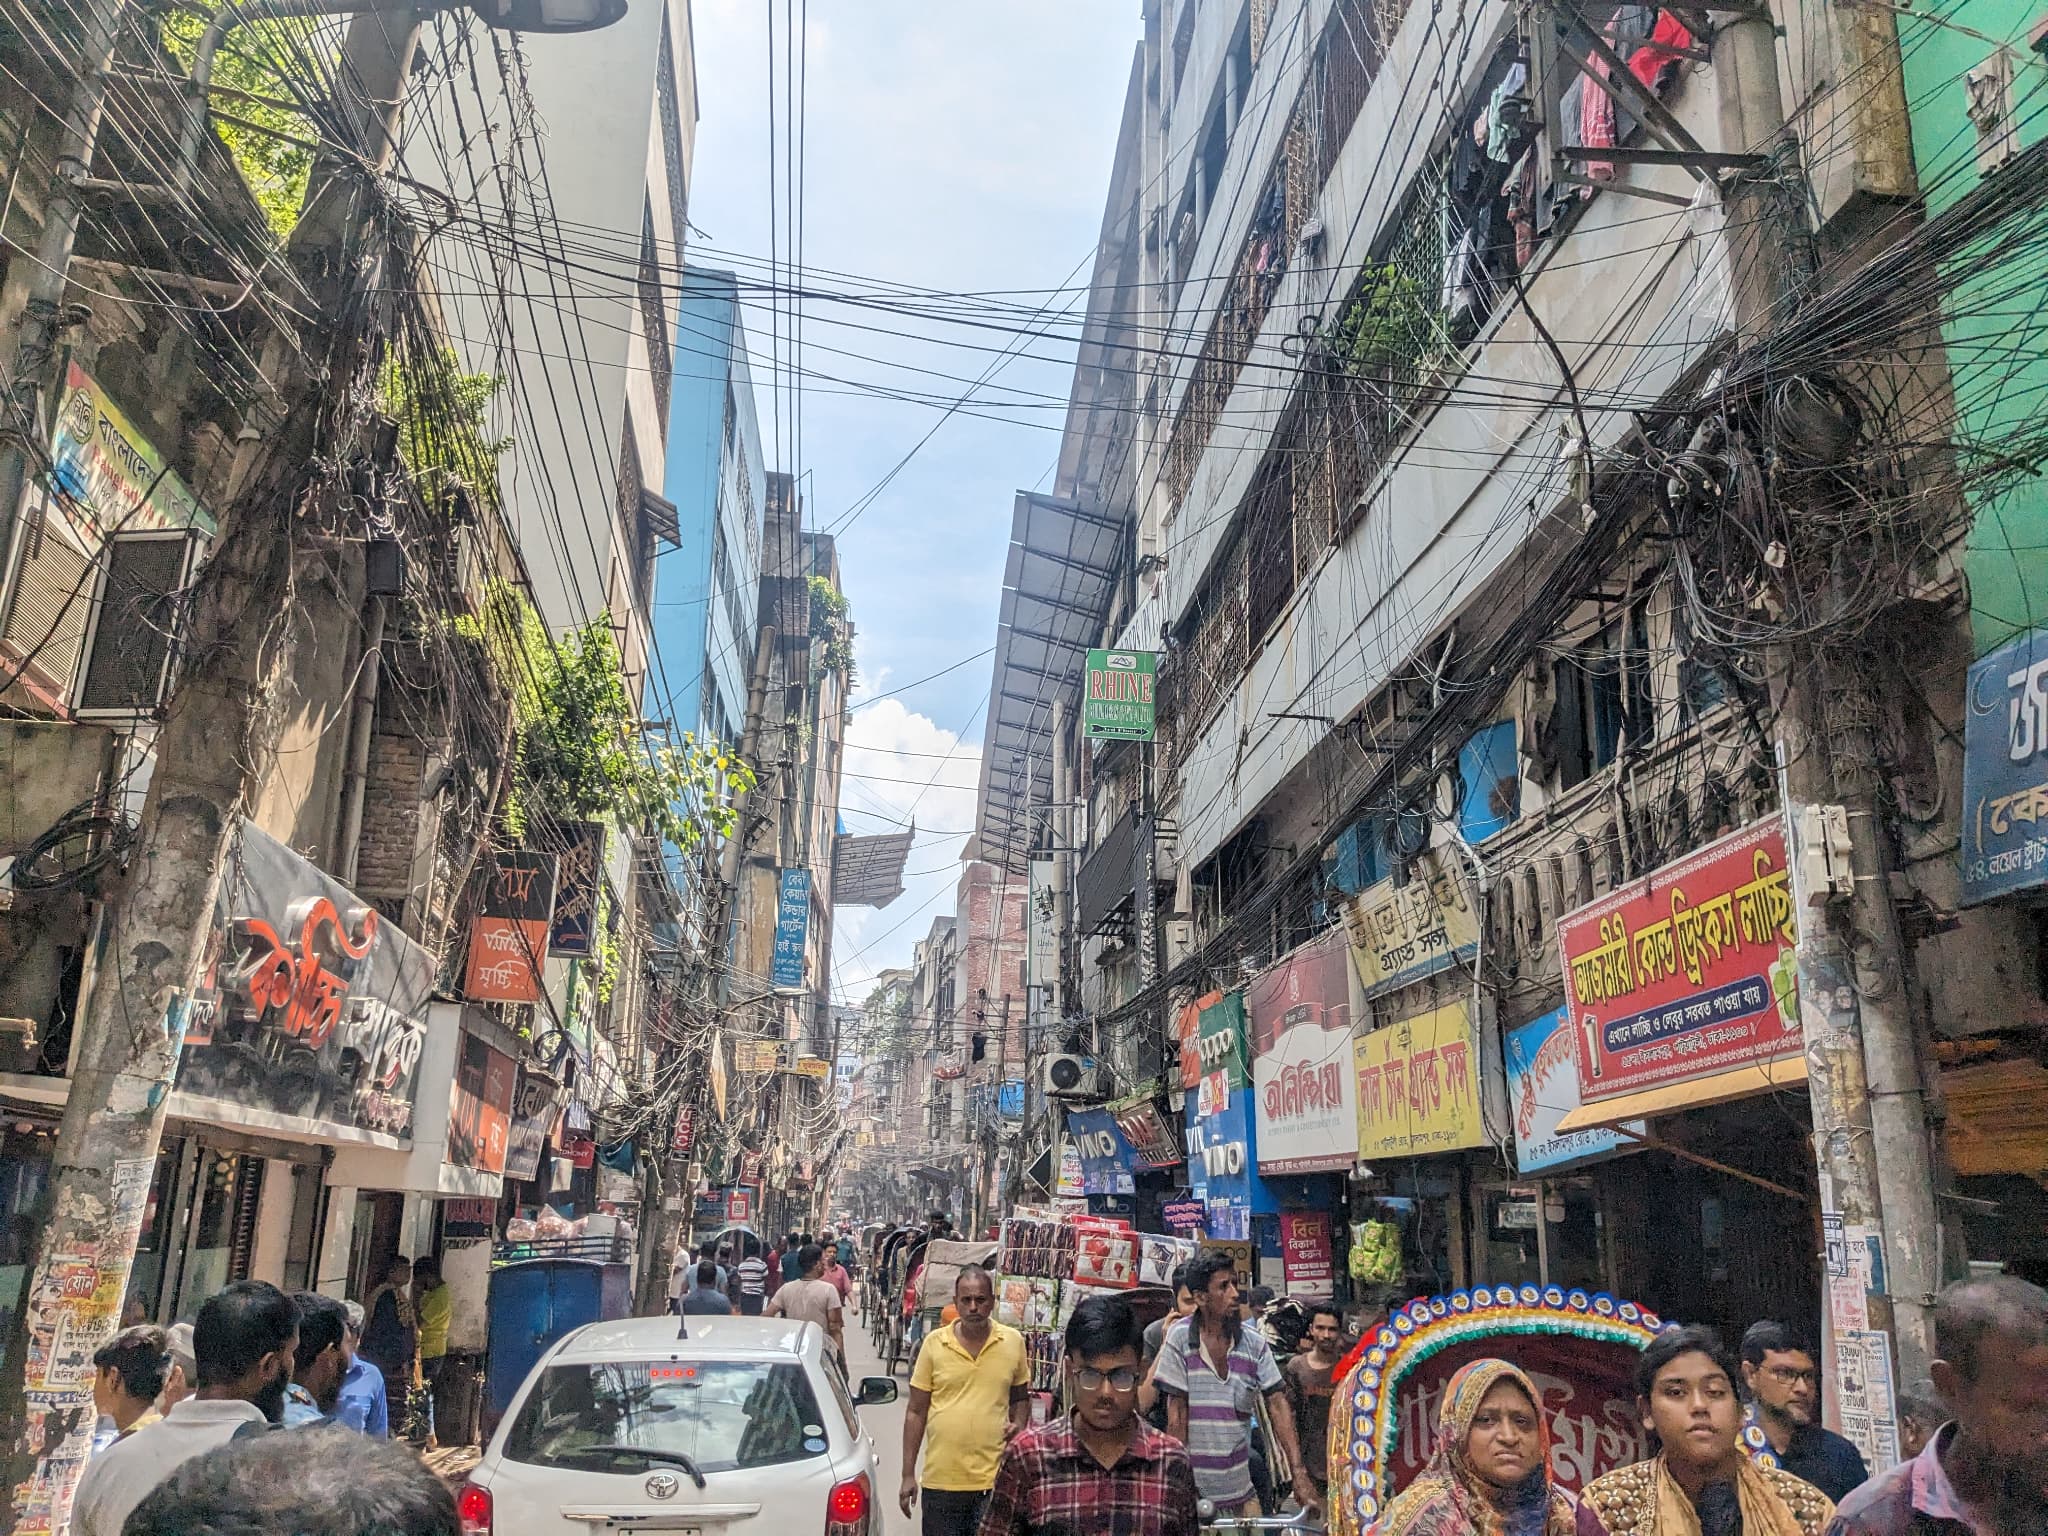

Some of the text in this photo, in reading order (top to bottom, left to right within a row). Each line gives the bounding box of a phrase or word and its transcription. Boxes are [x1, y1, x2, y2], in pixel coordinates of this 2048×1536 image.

[1090, 670, 1152, 703] RHINE
[1072, 1124, 1116, 1160] vivo
[1203, 1134, 1243, 1177] vivo
